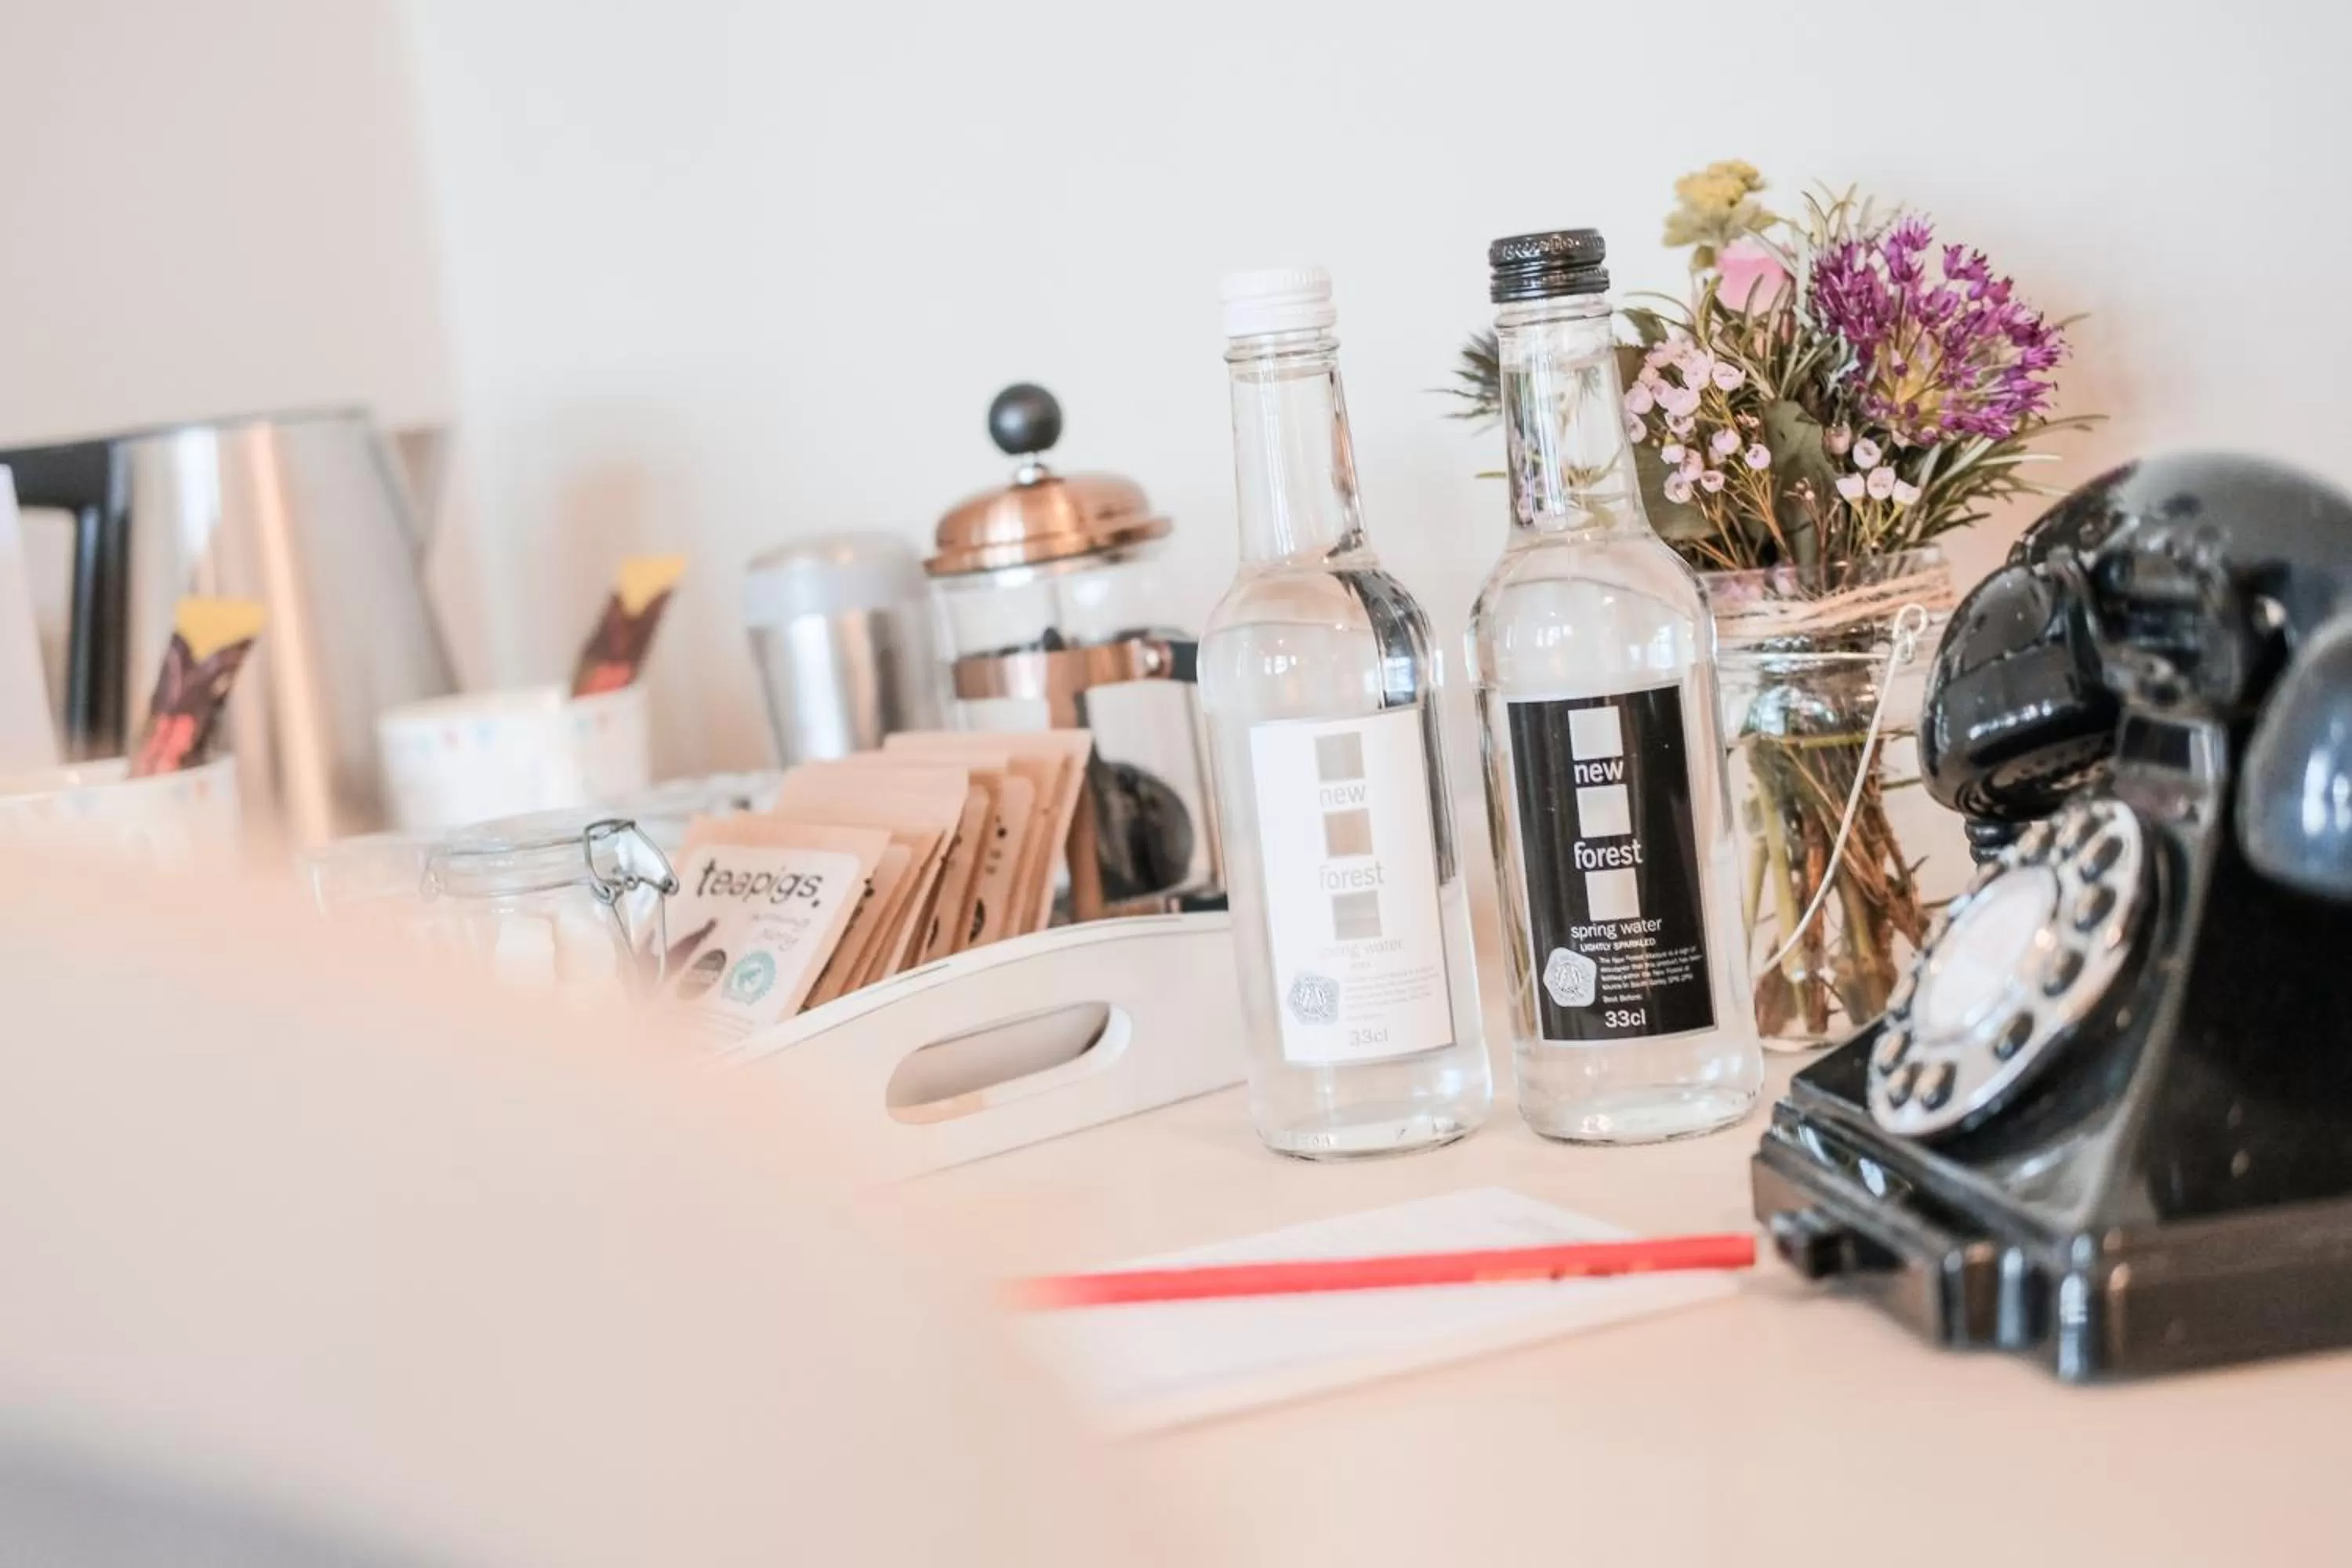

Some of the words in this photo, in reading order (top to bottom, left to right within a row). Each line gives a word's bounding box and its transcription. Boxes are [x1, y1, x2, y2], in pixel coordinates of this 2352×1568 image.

[1573, 760, 1624, 784] new
[1319, 785, 1367, 807] new
[1573, 838, 1643, 869] forest
[1319, 860, 1385, 891] forest
[1570, 924, 1617, 941] spring
[1620, 918, 1662, 935] water
[1319, 942, 1360, 959] ring
[1605, 1009, 1646, 1028] 33cl
[1348, 1027, 1388, 1047] 33cl
